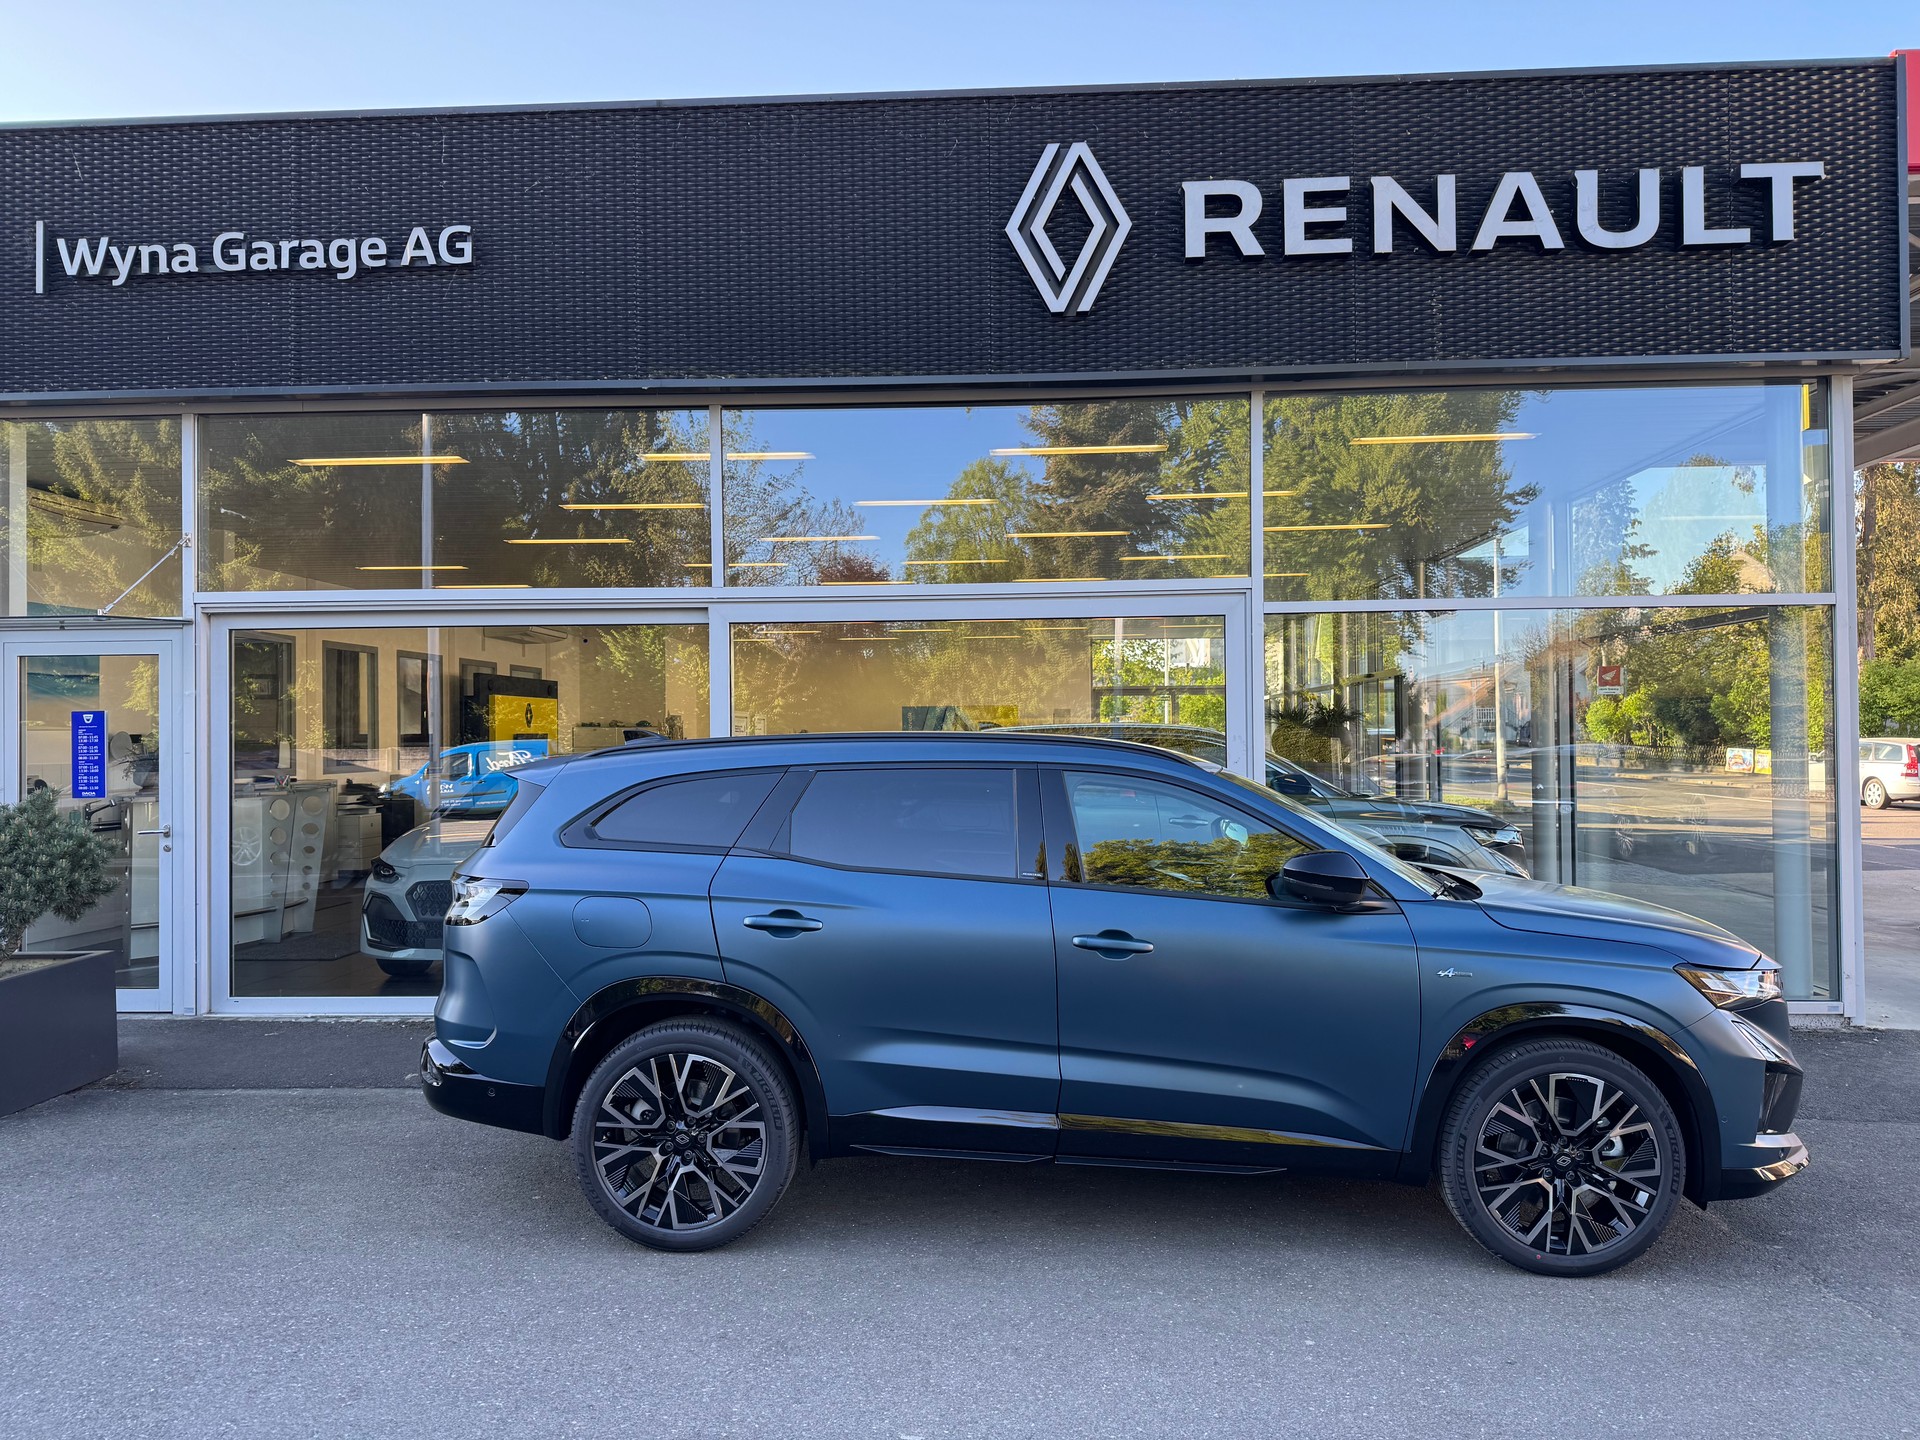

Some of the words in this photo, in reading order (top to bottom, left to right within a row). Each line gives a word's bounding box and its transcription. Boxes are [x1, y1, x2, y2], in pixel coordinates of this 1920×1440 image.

[1181, 161, 1826, 261] RENAULT
[56, 236, 199, 286] Wyna
[212, 231, 388, 280] Garage
[400, 225, 473, 267] AG
[1456, 1136, 1471, 1200] MICHELIN
[1667, 1127, 1680, 1194] MICHELIN
